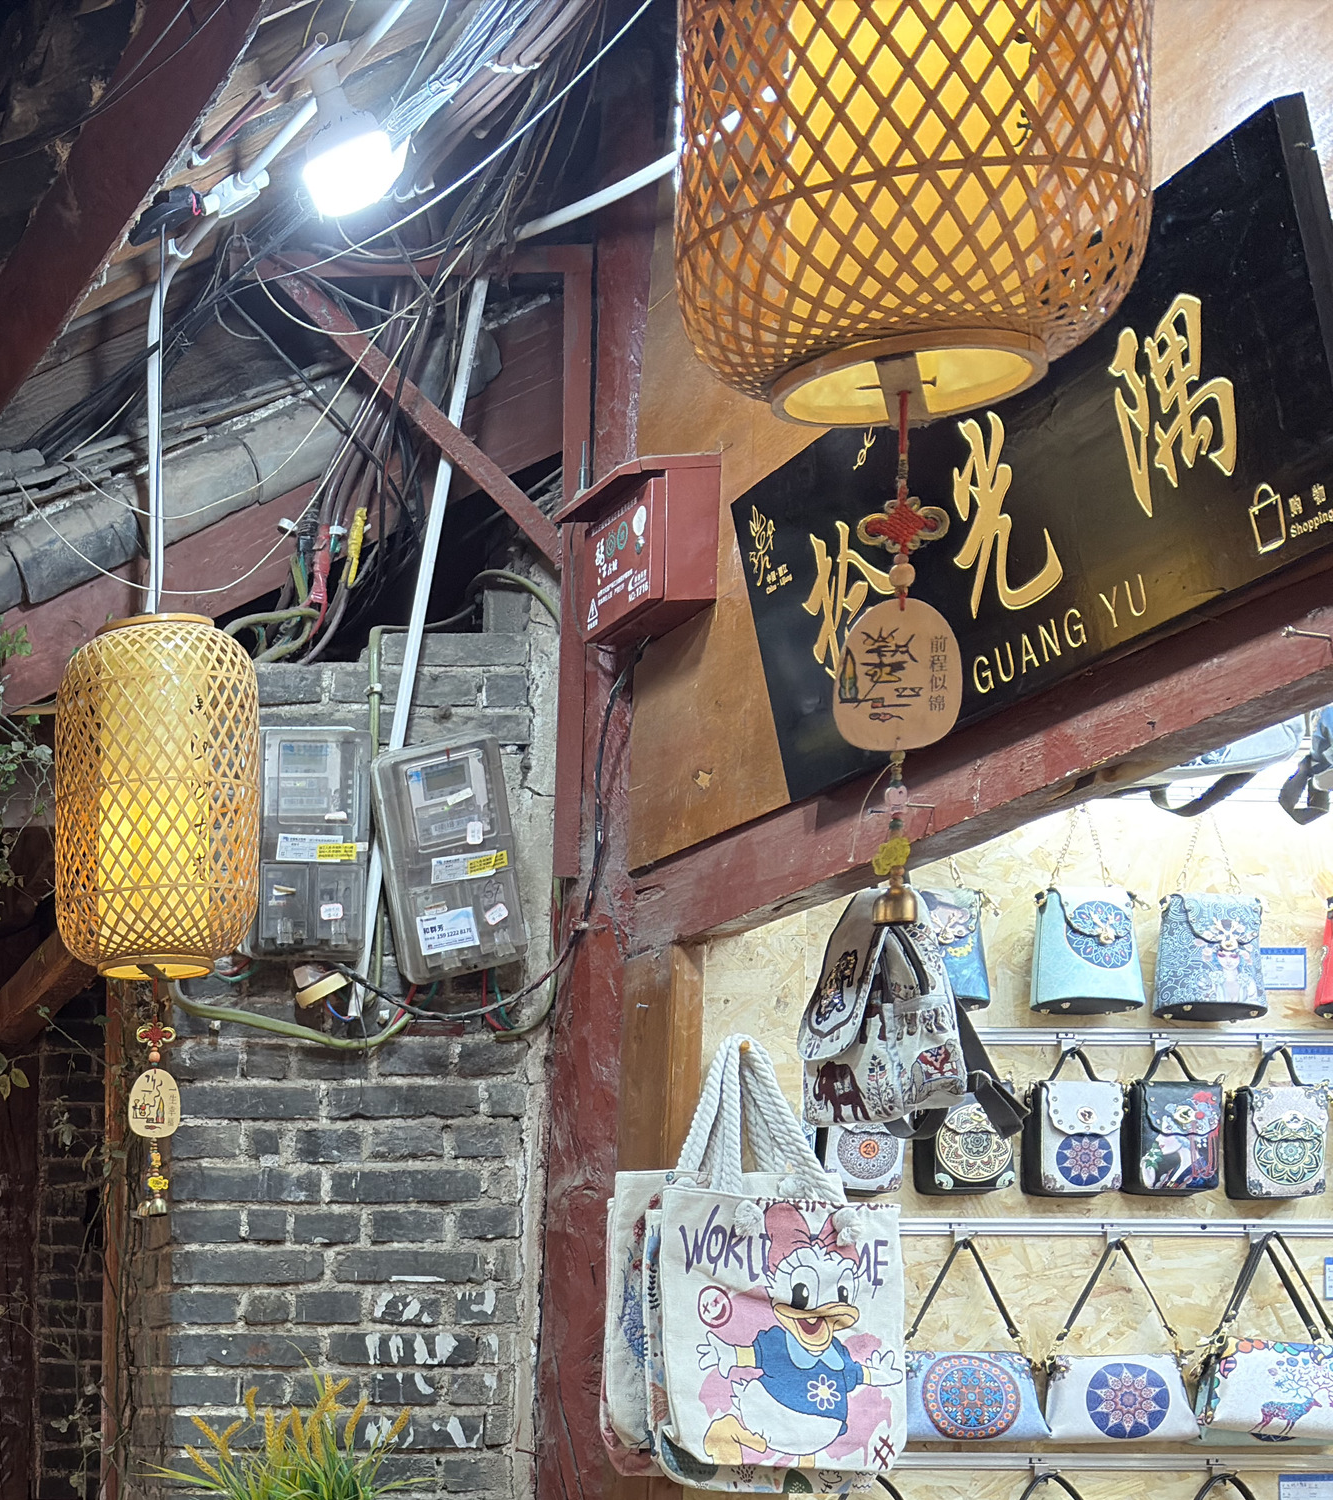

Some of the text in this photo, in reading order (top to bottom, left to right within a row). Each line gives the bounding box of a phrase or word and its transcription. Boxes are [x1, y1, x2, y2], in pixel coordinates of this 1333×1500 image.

[928, 634, 948, 712] 前程似锦
[973, 573, 1148, 694] GUANG YU
